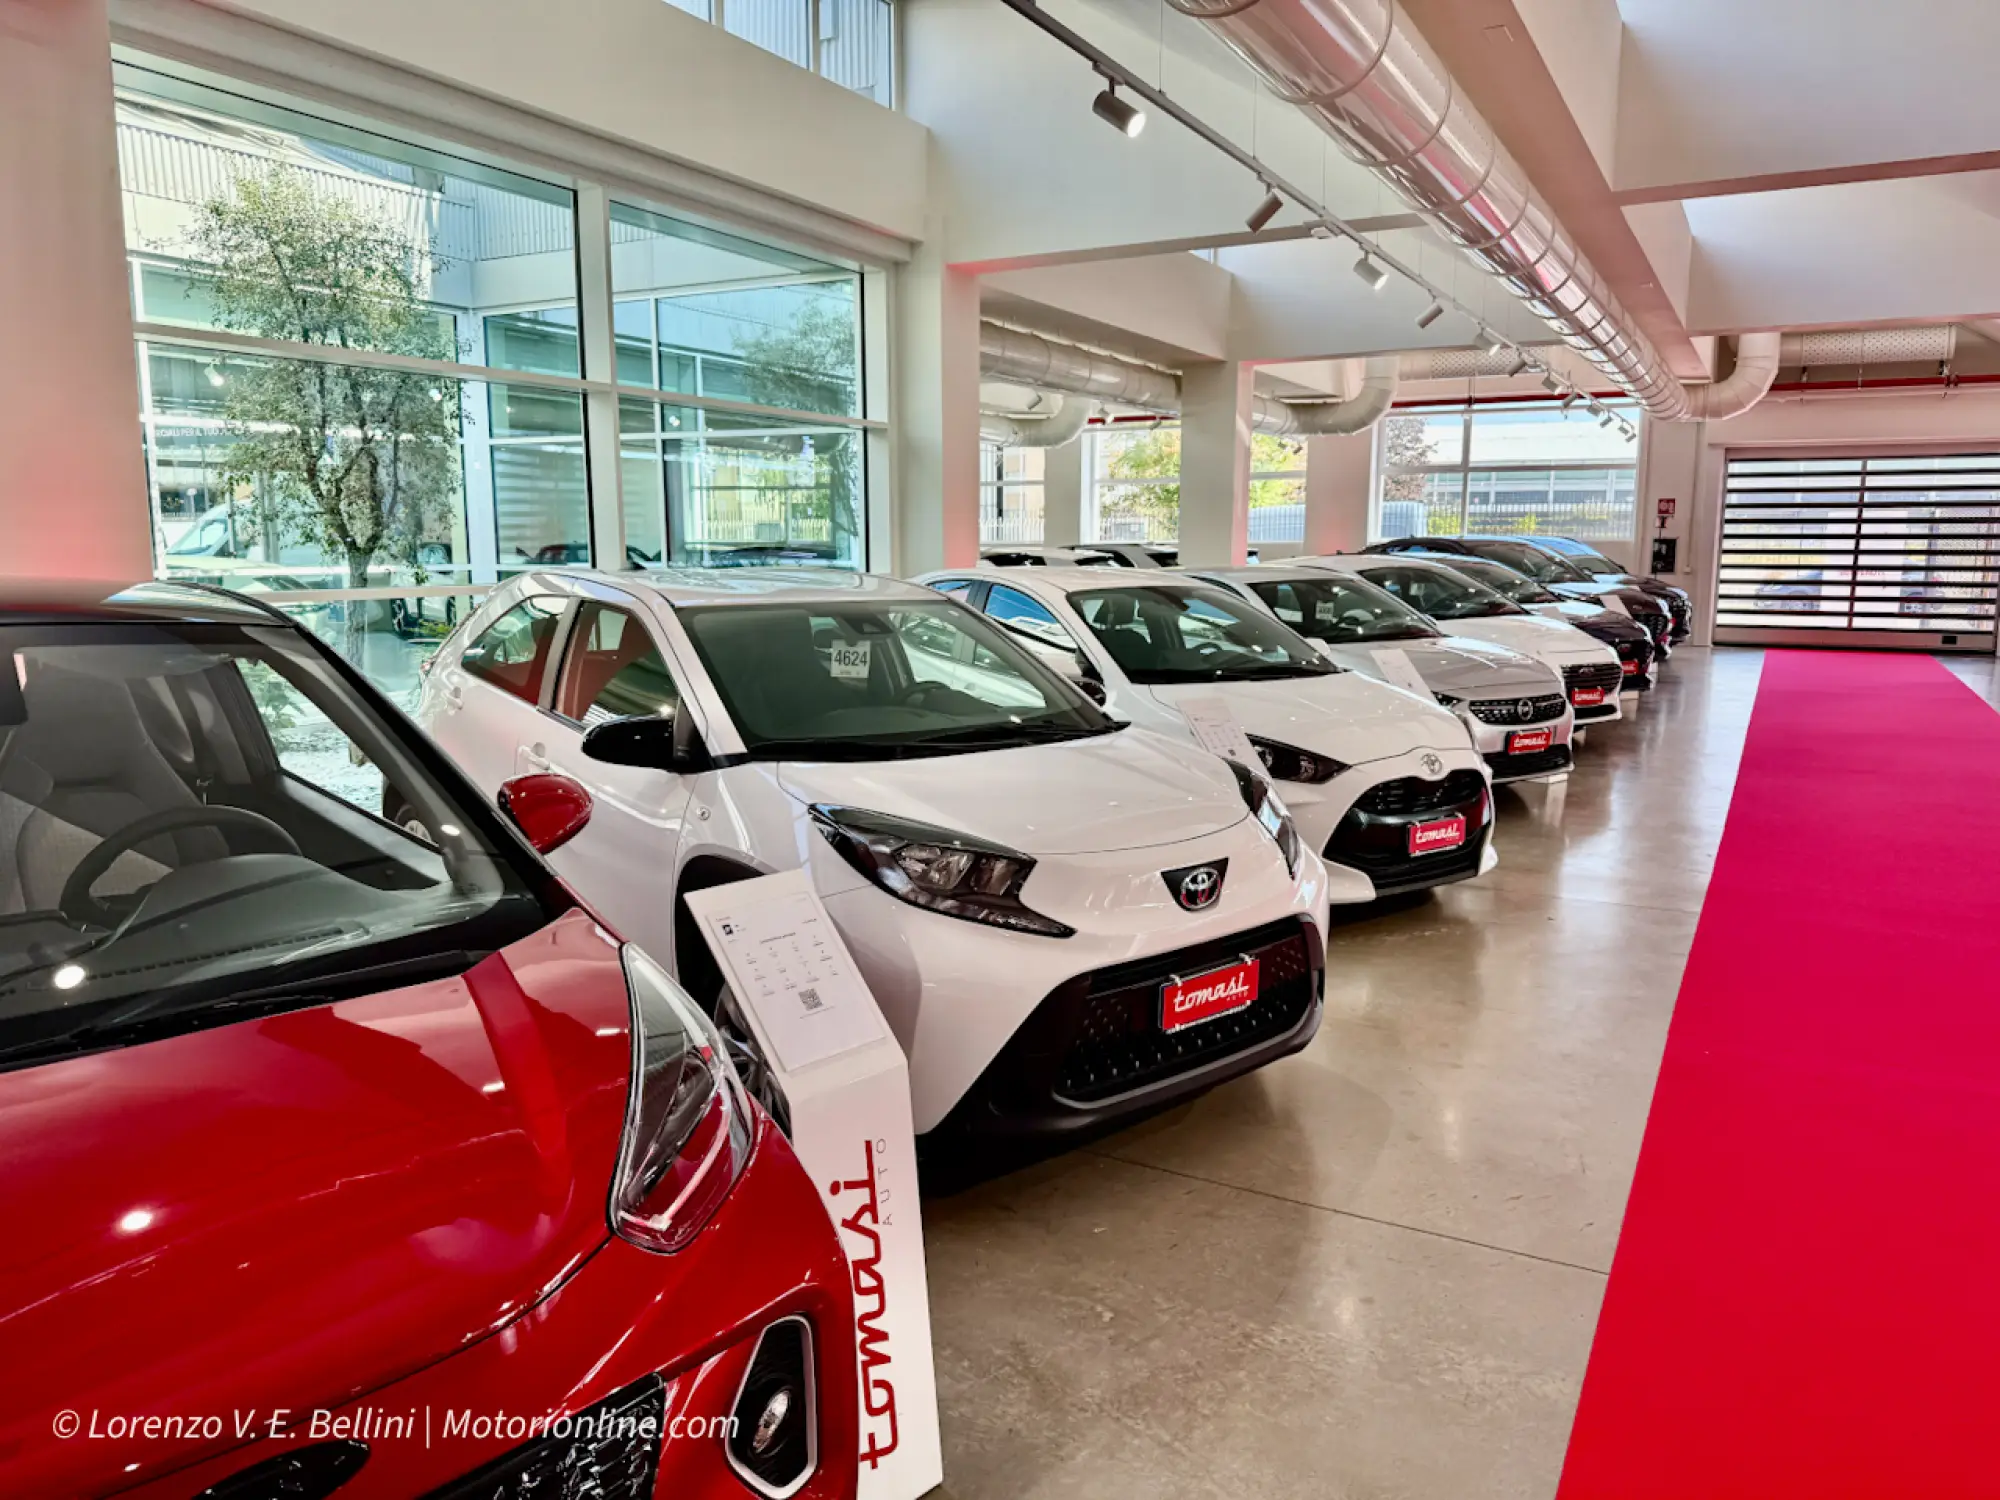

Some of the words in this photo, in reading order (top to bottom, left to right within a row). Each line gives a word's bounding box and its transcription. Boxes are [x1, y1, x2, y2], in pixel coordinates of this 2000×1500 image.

[834, 649, 868, 667] 4624
[1415, 823, 1460, 844] tomasi
[1173, 971, 1250, 1012] tomasi
[876, 1138, 893, 1226] AUTO
[829, 1140, 898, 1470] tomasi
